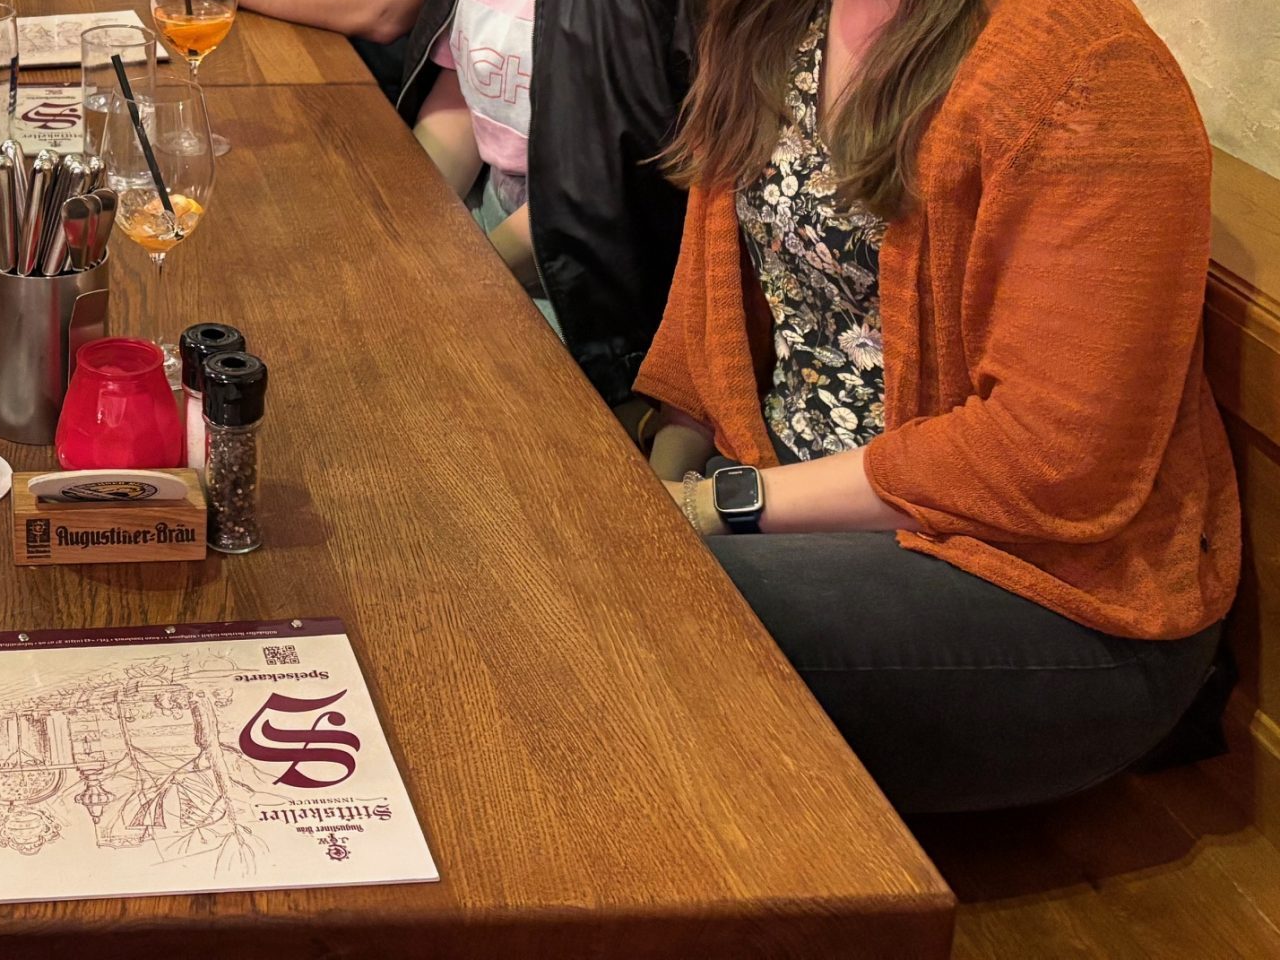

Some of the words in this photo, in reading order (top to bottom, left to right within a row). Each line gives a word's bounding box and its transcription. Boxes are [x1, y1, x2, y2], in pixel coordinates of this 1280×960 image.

[234, 670, 329, 682] Speisekarte
[287, 797, 354, 806] INNSBRUCK
[258, 805, 392, 824] Stiftskeller
[315, 824, 364, 834] Augustiner
